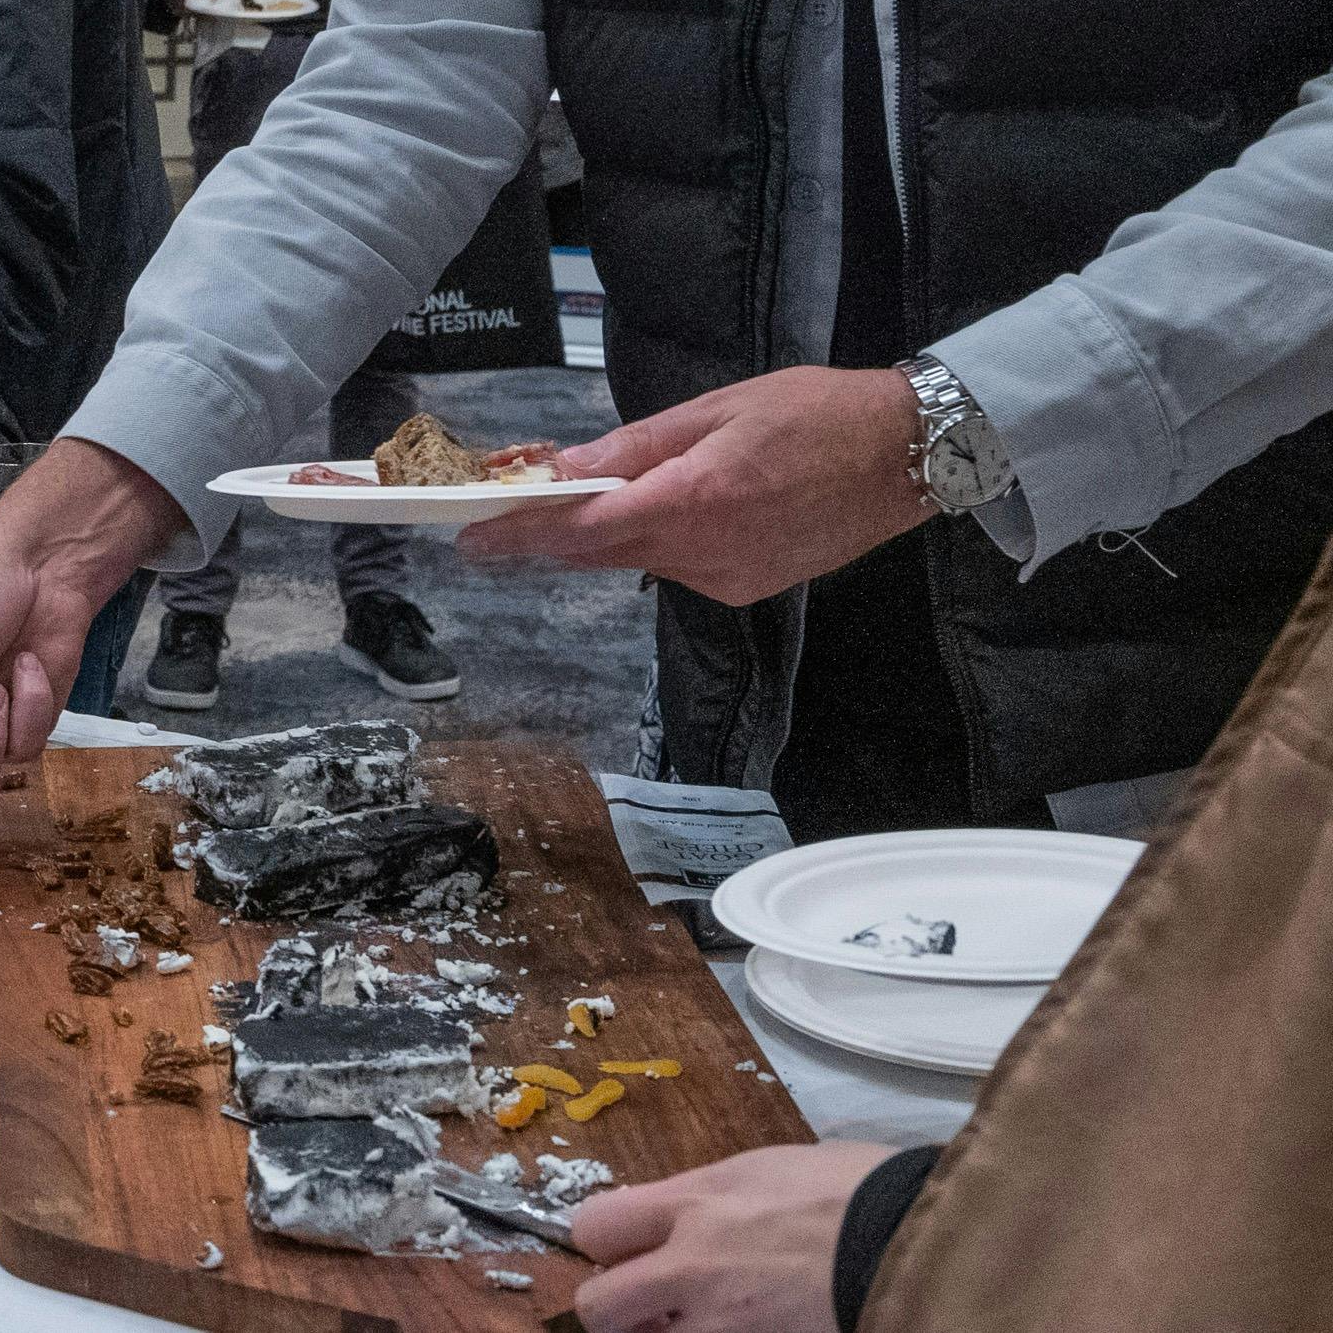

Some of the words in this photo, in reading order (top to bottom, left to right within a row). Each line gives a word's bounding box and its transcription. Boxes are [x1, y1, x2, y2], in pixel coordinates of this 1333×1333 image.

[429, 306, 522, 336] FESTIVAL
[653, 839, 765, 853] CHEESE
[672, 852, 755, 862] GOAT
